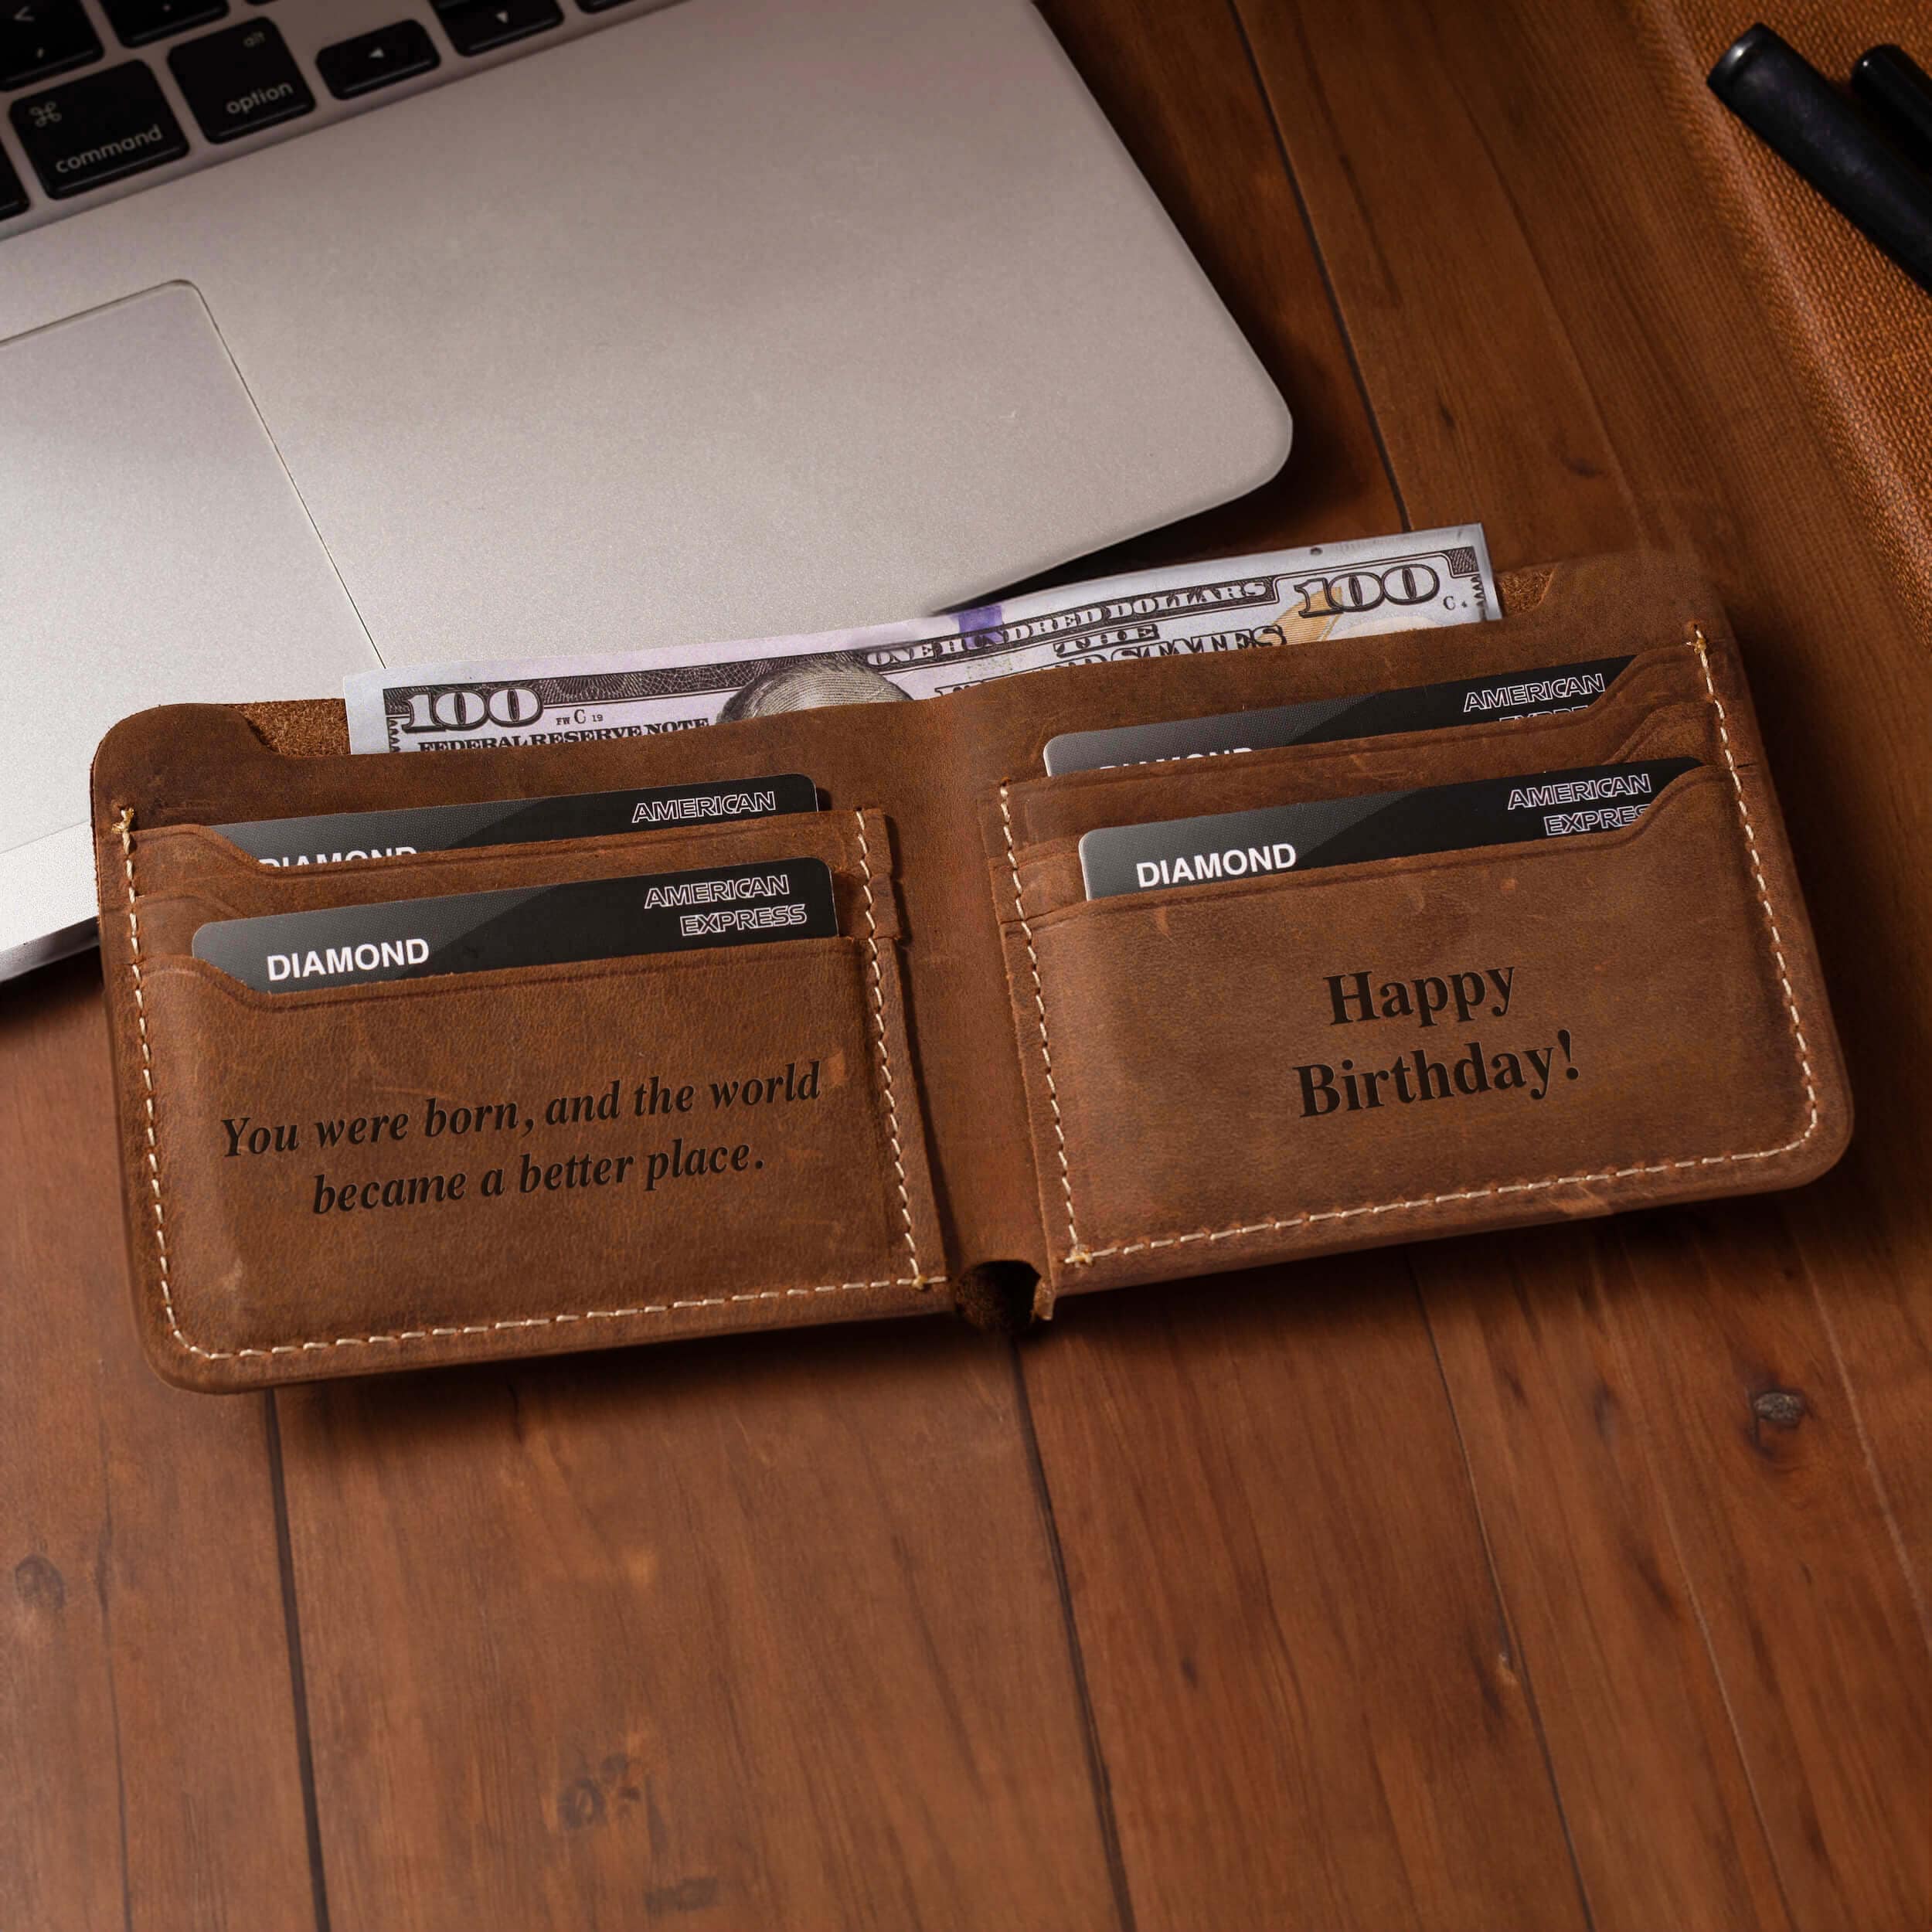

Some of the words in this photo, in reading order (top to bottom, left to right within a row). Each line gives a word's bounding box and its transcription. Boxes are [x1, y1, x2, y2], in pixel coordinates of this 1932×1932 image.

[226, 81, 294, 115] option
[55, 124, 163, 174] command
[1293, 563, 1440, 618] 100
[866, 643, 934, 667] ONE
[935, 606, 1102, 657] HUNDRED
[1108, 581, 1267, 620] DOLLARS
[1053, 624, 1159, 658] THE
[401, 686, 544, 733] 100
[1463, 672, 1606, 713] AMERICAN
[529, 725, 642, 747] RESERVE
[573, 709, 587, 724] C
[631, 791, 776, 824] AMERICAN
[1507, 774, 1651, 810] AMERICAN
[1136, 842, 1297, 888] DIAMOND
[644, 874, 790, 910] AMERICAN
[679, 903, 807, 937] EXPRESS
[267, 938, 429, 981] DIAMOND
[1322, 966, 1515, 1028] Happy
[1292, 1029, 1579, 1117] Birthday!
[221, 1116, 299, 1158] You
[313, 1111, 409, 1148] were
[423, 1097, 534, 1138] born,
[545, 1079, 621, 1125] and
[633, 1076, 694, 1116] the
[709, 1060, 821, 1107] world
[311, 1172, 467, 1214] became
[480, 1167, 505, 1196] a
[519, 1153, 635, 1193] better
[645, 1136, 765, 1191] place.
